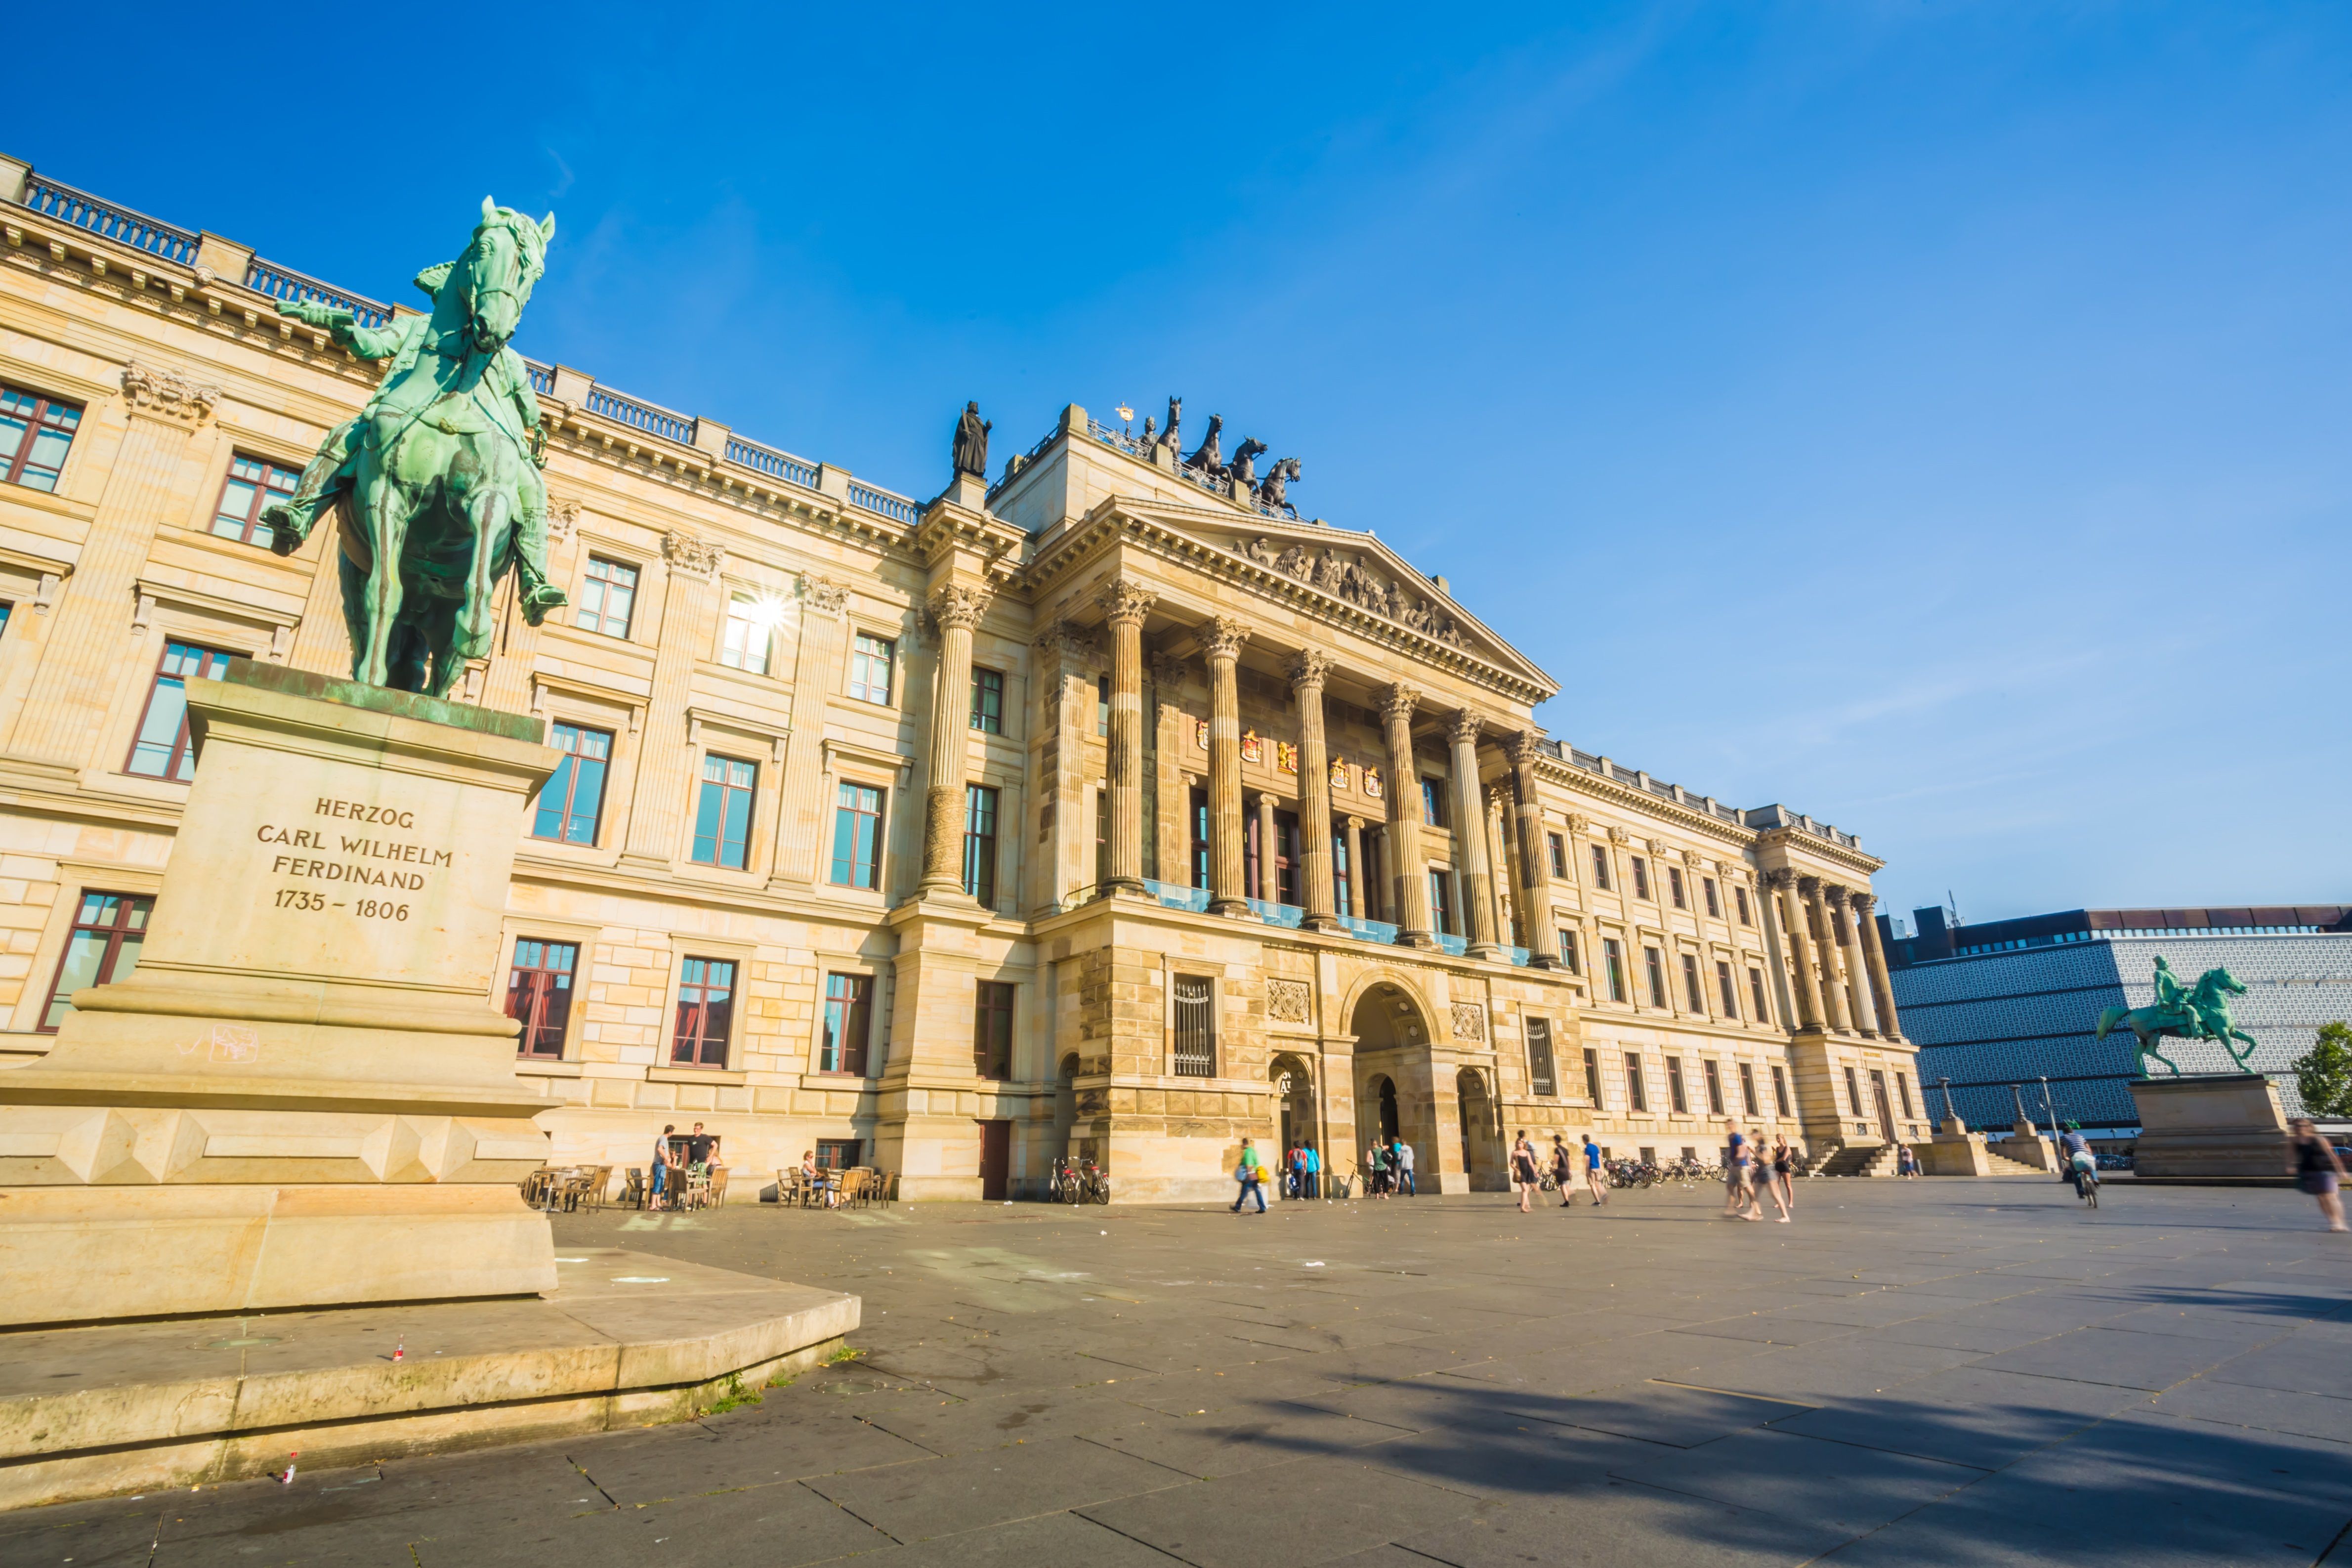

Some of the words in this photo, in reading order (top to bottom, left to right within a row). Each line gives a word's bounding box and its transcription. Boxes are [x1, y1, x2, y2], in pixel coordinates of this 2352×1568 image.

[315, 798, 414, 829] HERZOG
[257, 825, 327, 850] CARL
[340, 836, 453, 868] WILHELM
[272, 855, 424, 890] FERDINAND
[275, 889, 326, 911] 1735
[356, 899, 410, 922] 1806
